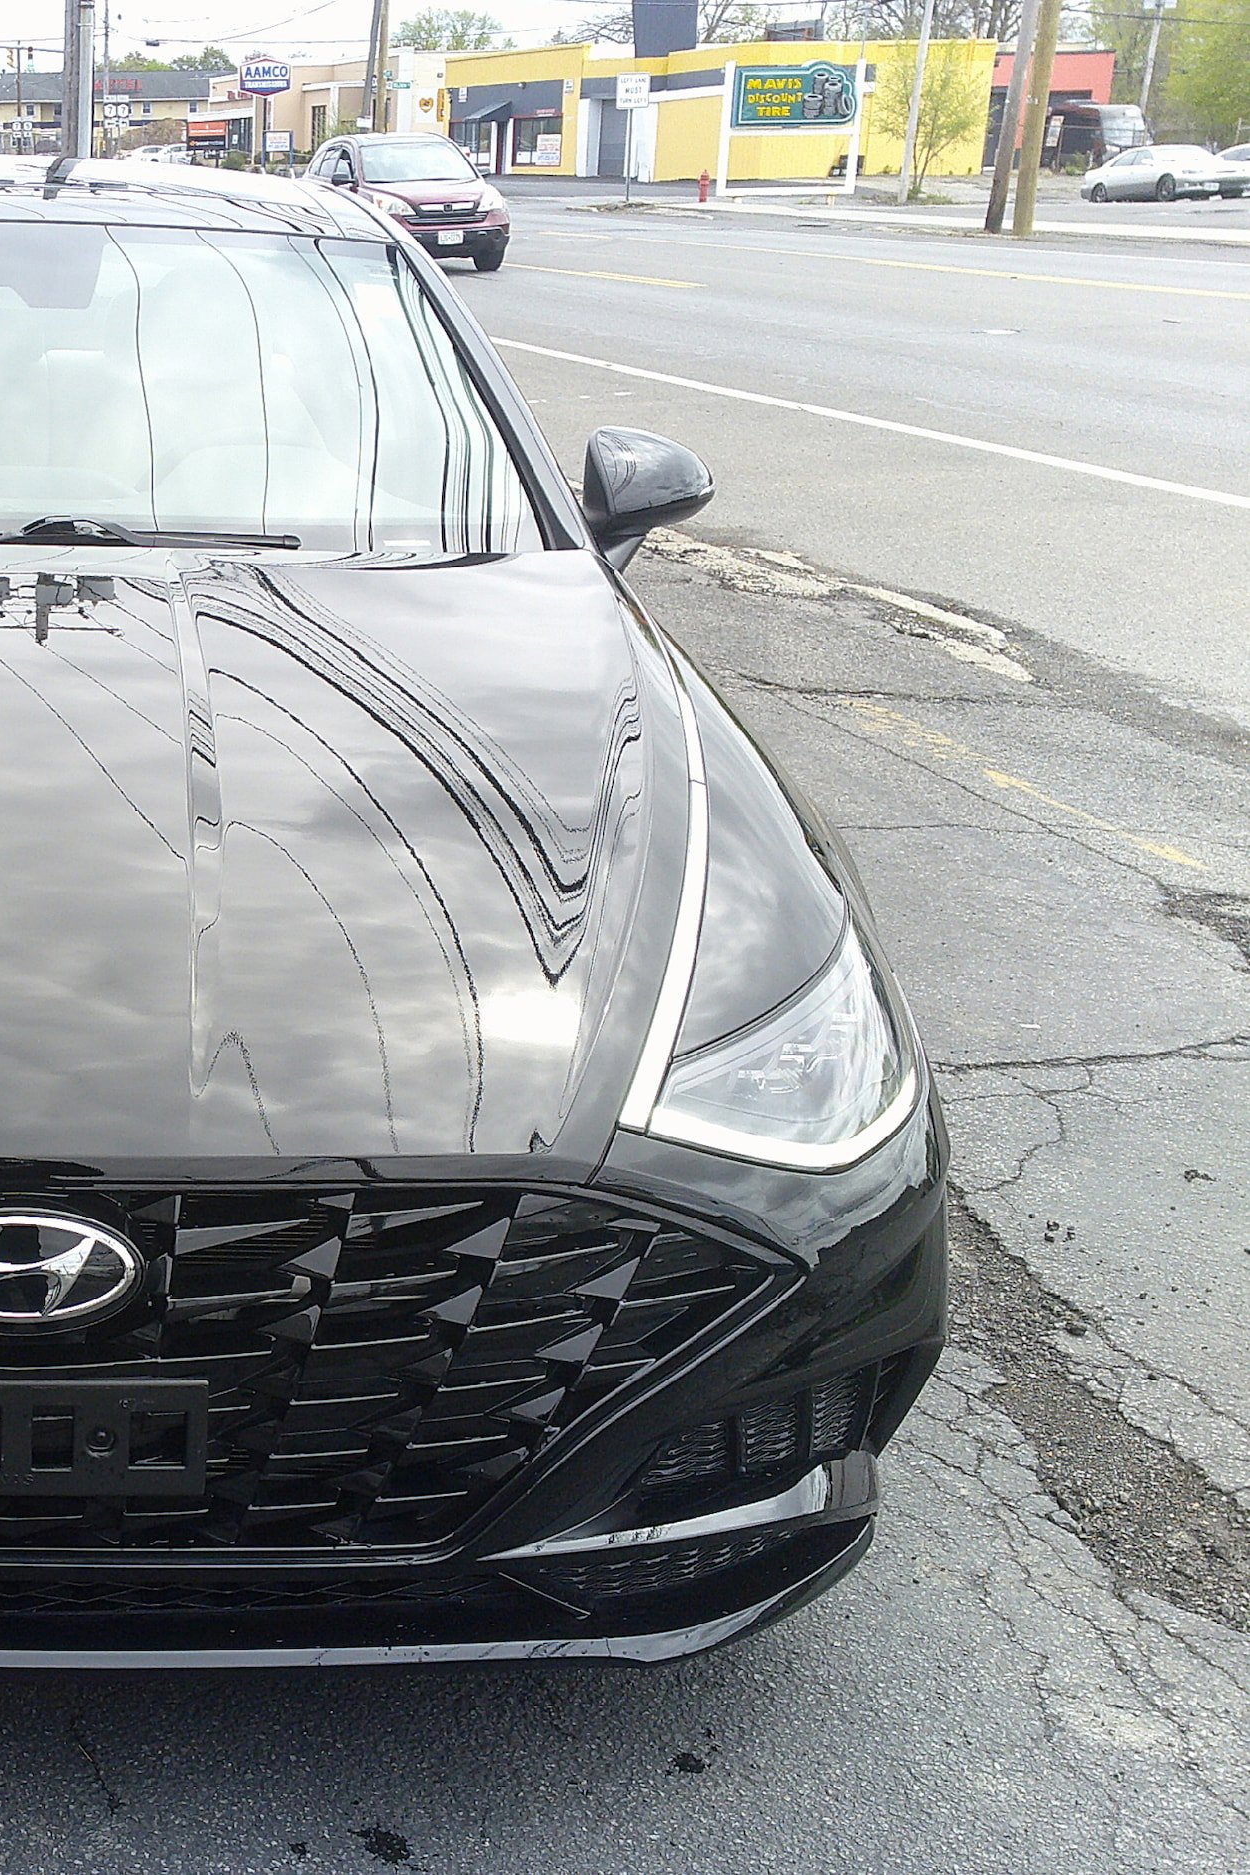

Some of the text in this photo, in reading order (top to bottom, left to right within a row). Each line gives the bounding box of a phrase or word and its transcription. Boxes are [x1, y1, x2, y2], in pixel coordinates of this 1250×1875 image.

[244, 65, 288, 79] AAMCO
[747, 78, 802, 89] MAVIS
[625, 86, 642, 94] MUST
[747, 92, 803, 104] DISCOUNT
[756, 106, 791, 117] TIRE
